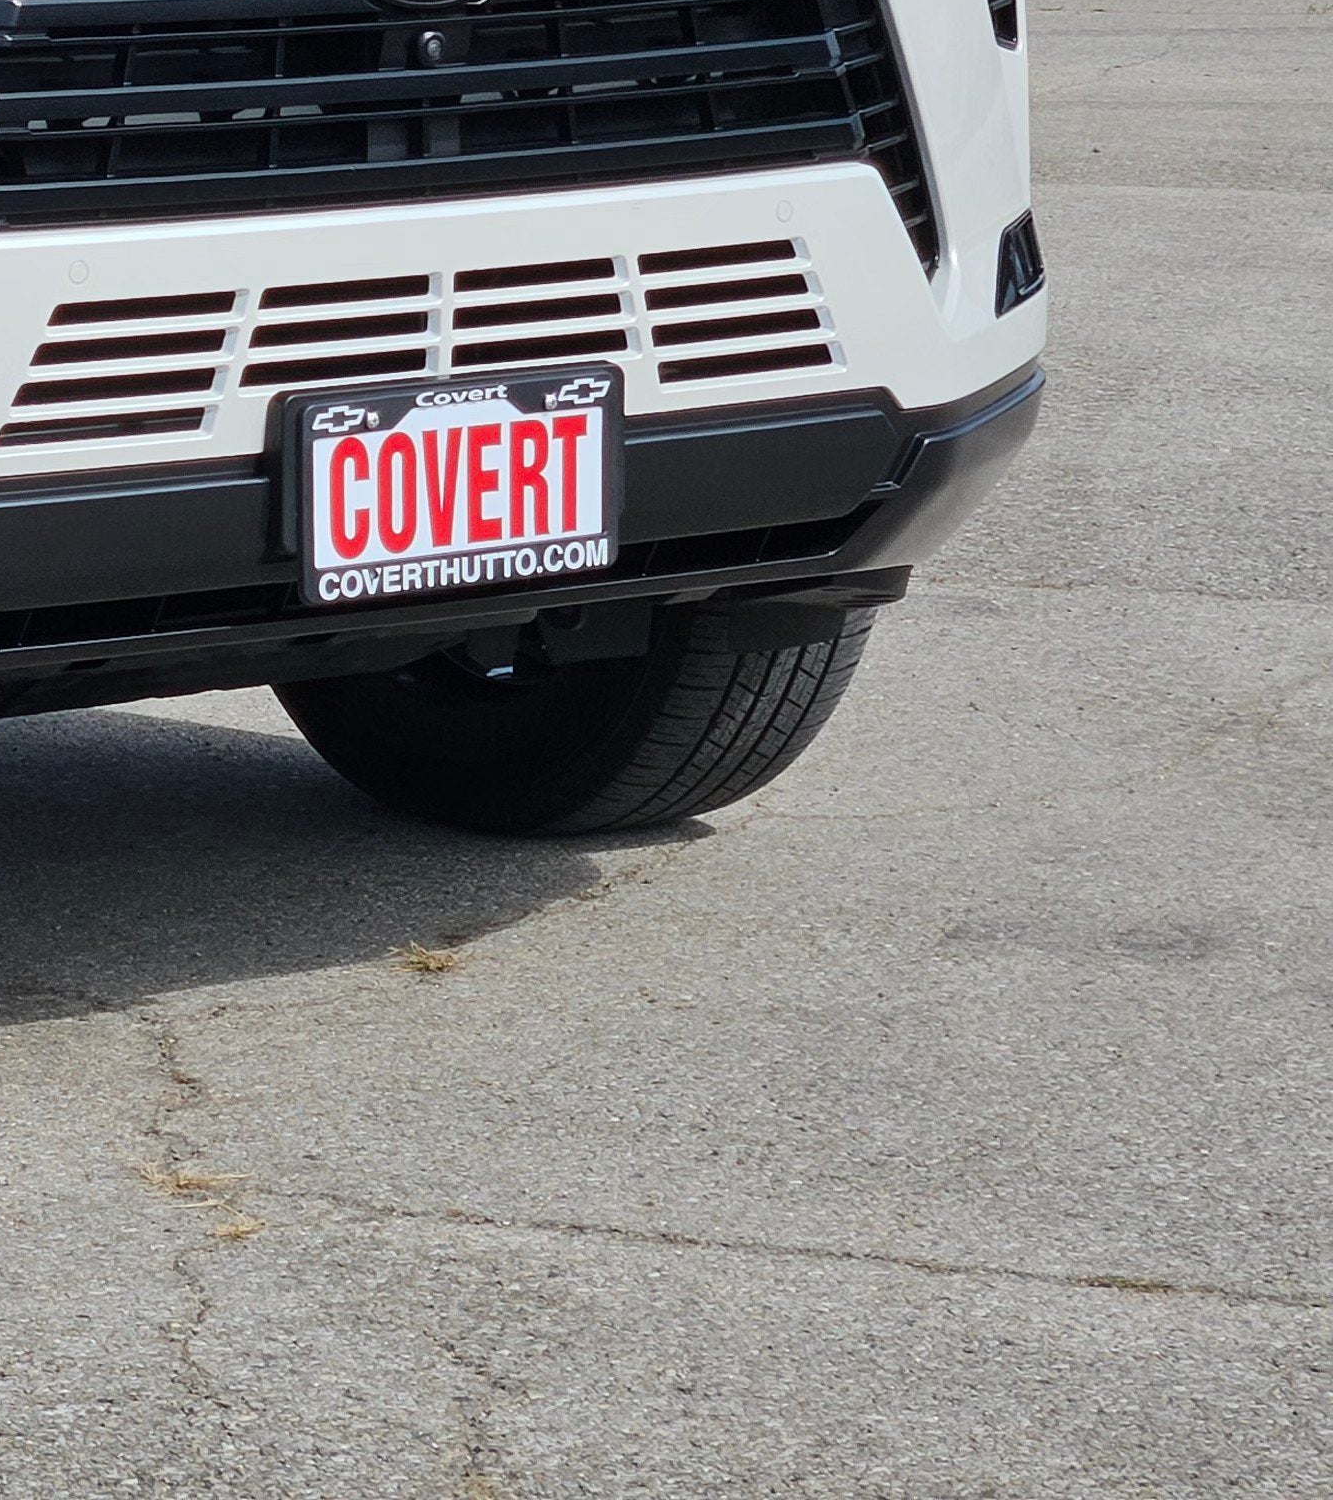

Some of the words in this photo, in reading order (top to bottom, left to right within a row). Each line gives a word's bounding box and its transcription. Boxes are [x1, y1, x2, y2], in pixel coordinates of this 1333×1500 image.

[416, 384, 508, 407] Covert
[329, 414, 588, 560] COVERT
[318, 538, 609, 601] COVERTHUTTO.COM
